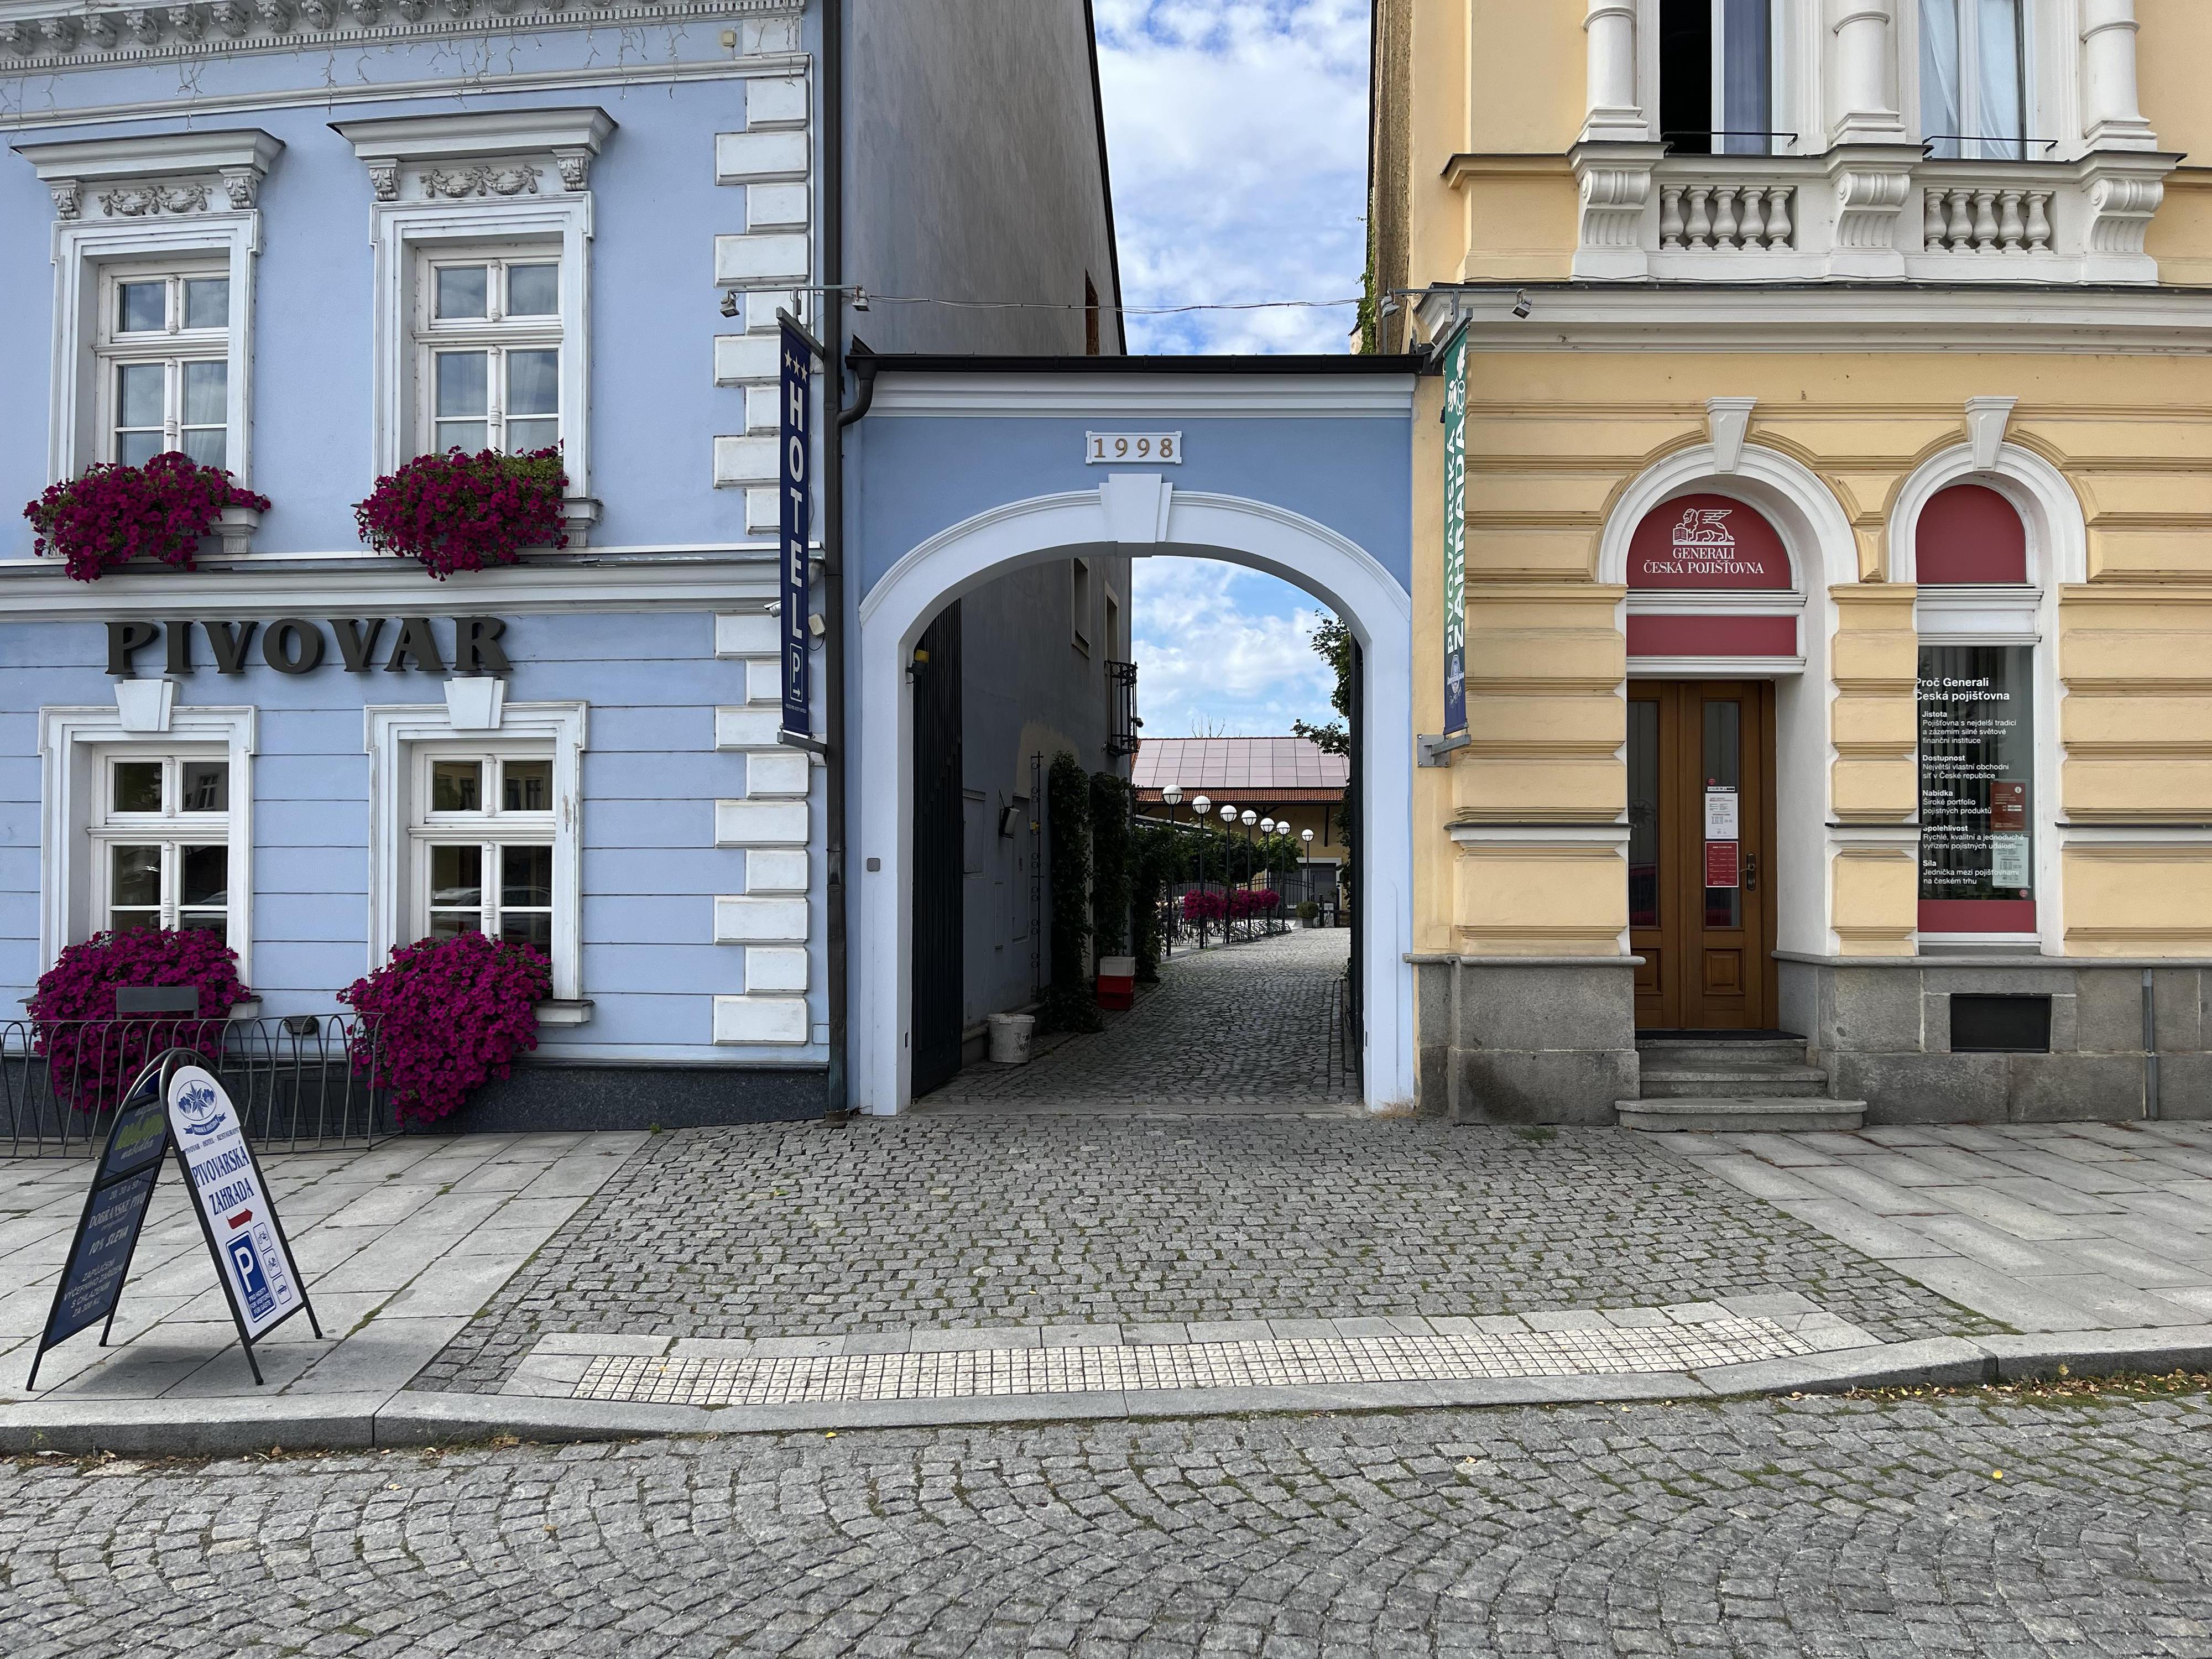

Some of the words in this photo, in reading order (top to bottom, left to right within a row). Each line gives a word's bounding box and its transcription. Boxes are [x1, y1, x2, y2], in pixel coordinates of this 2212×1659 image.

[1093, 438, 1173, 458] 1998
[789, 379, 804, 640] HOTEL
[1447, 427, 1455, 655] PIVOVARSKÁ
[1454, 415, 1465, 650] ZAHRADA
[1643, 560, 1684, 573] ČESKÁ
[1687, 560, 1765, 573] POJIŠŤOVNA
[1672, 547, 1735, 560] GENERALI
[103, 617, 514, 675] PIVOVAR
[792, 652, 801, 684] P
[1917, 677, 1940, 687] Proč
[1943, 677, 1989, 687] Generali
[1917, 689, 1949, 701] Česká
[1952, 691, 2010, 702] pojišťovna
[1923, 825, 1968, 833] Spolehlivost
[191, 1140, 250, 1188] PIVOVARSKÁ
[208, 1177, 254, 1216] ZAHRADA
[88, 1237, 106, 1256] 10%
[105, 1225, 129, 1248] SLEVA
[234, 1246, 253, 1293] P
